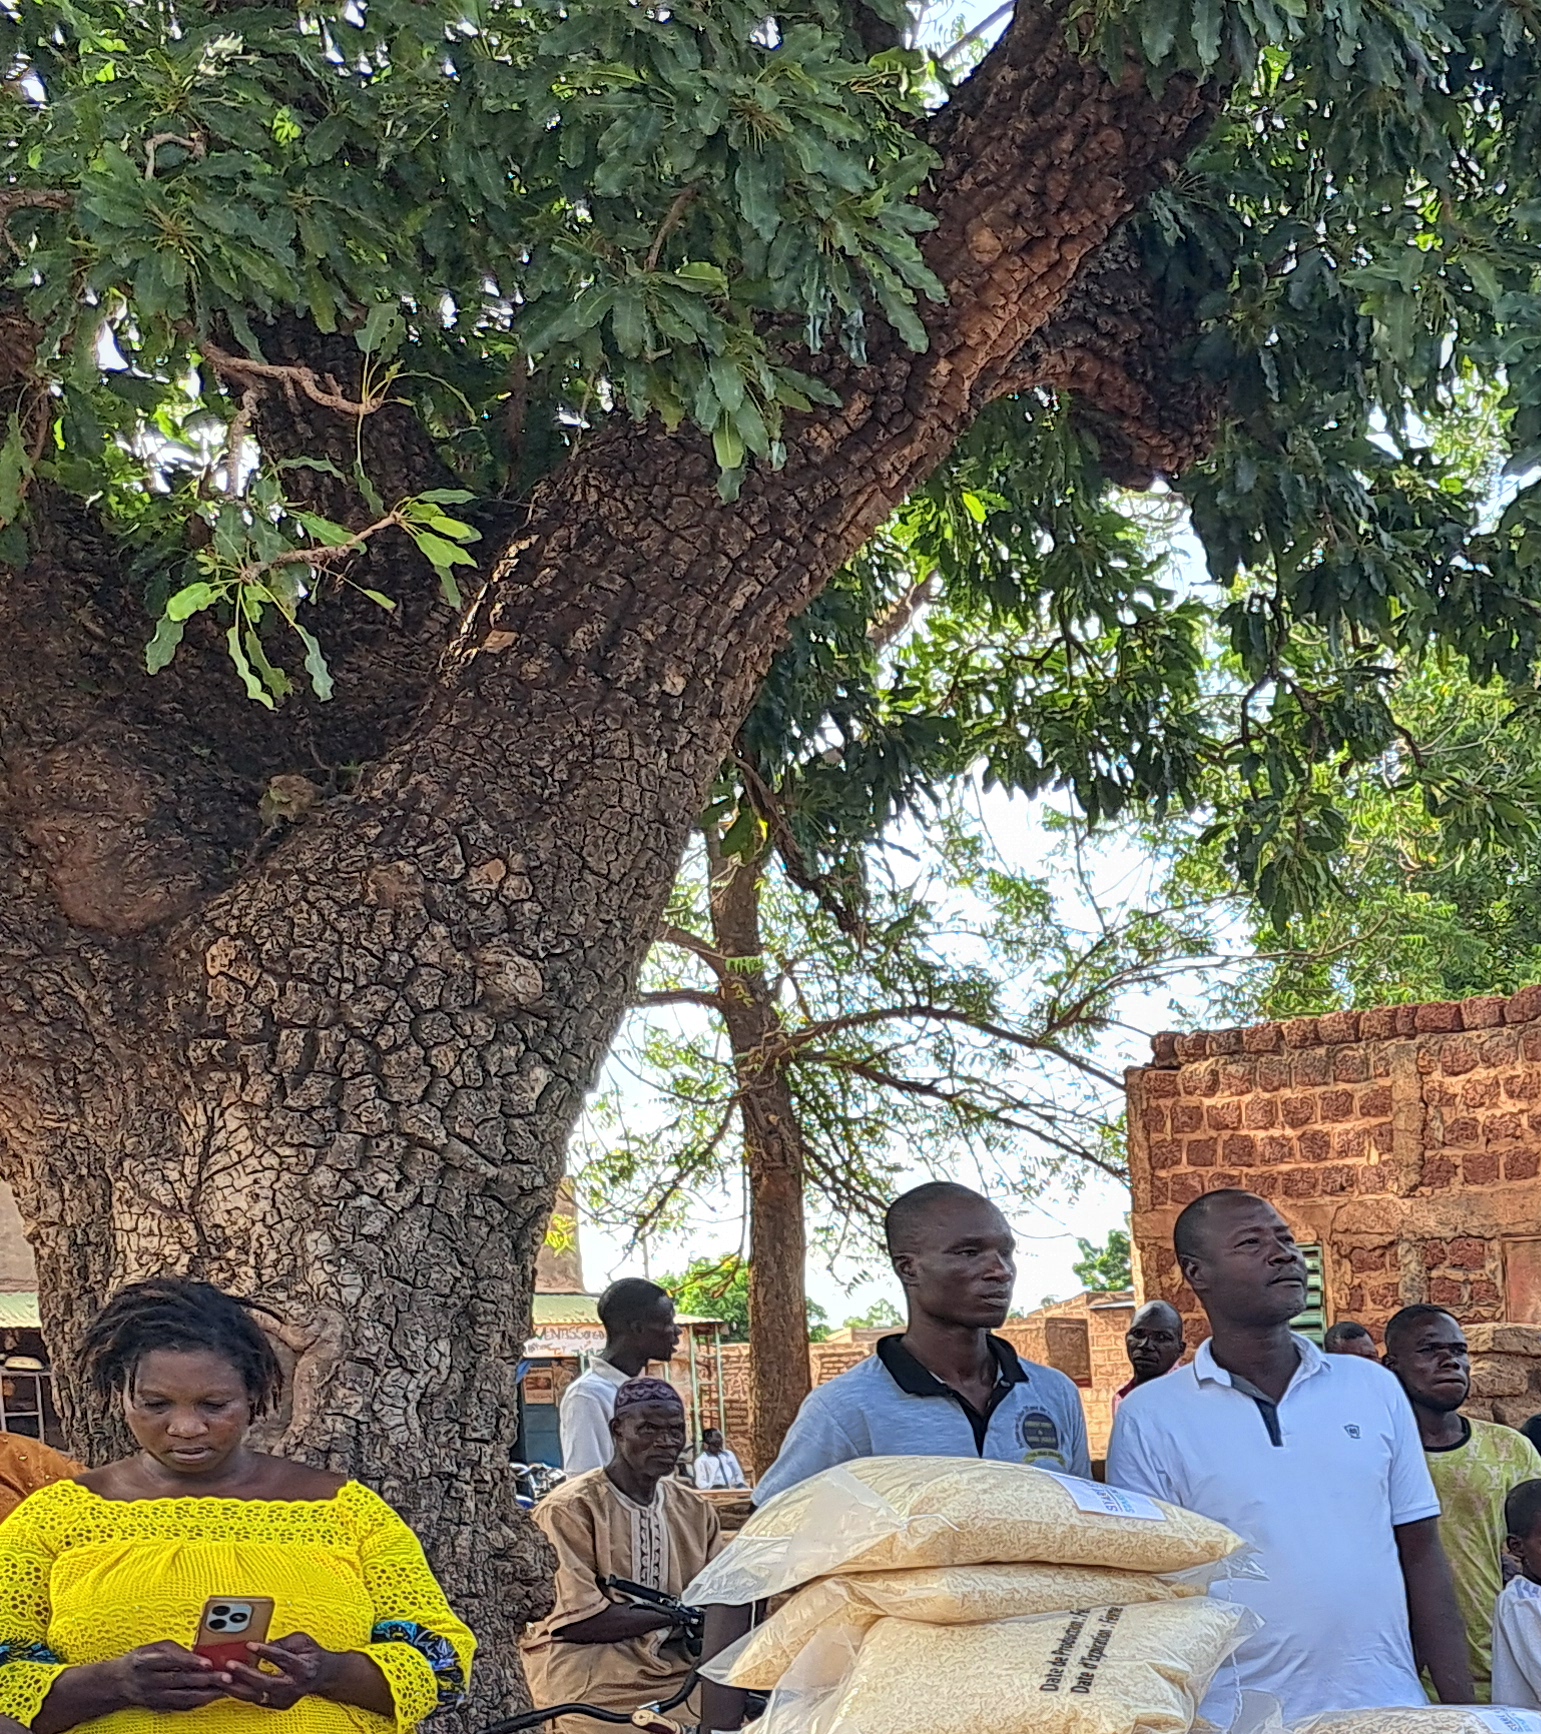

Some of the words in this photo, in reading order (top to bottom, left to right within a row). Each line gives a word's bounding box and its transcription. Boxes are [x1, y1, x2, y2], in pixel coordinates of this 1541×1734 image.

[1045, 1656, 1069, 1667] de
[1039, 1668, 1064, 1692] Date
[1070, 1671, 1095, 1694] Date
